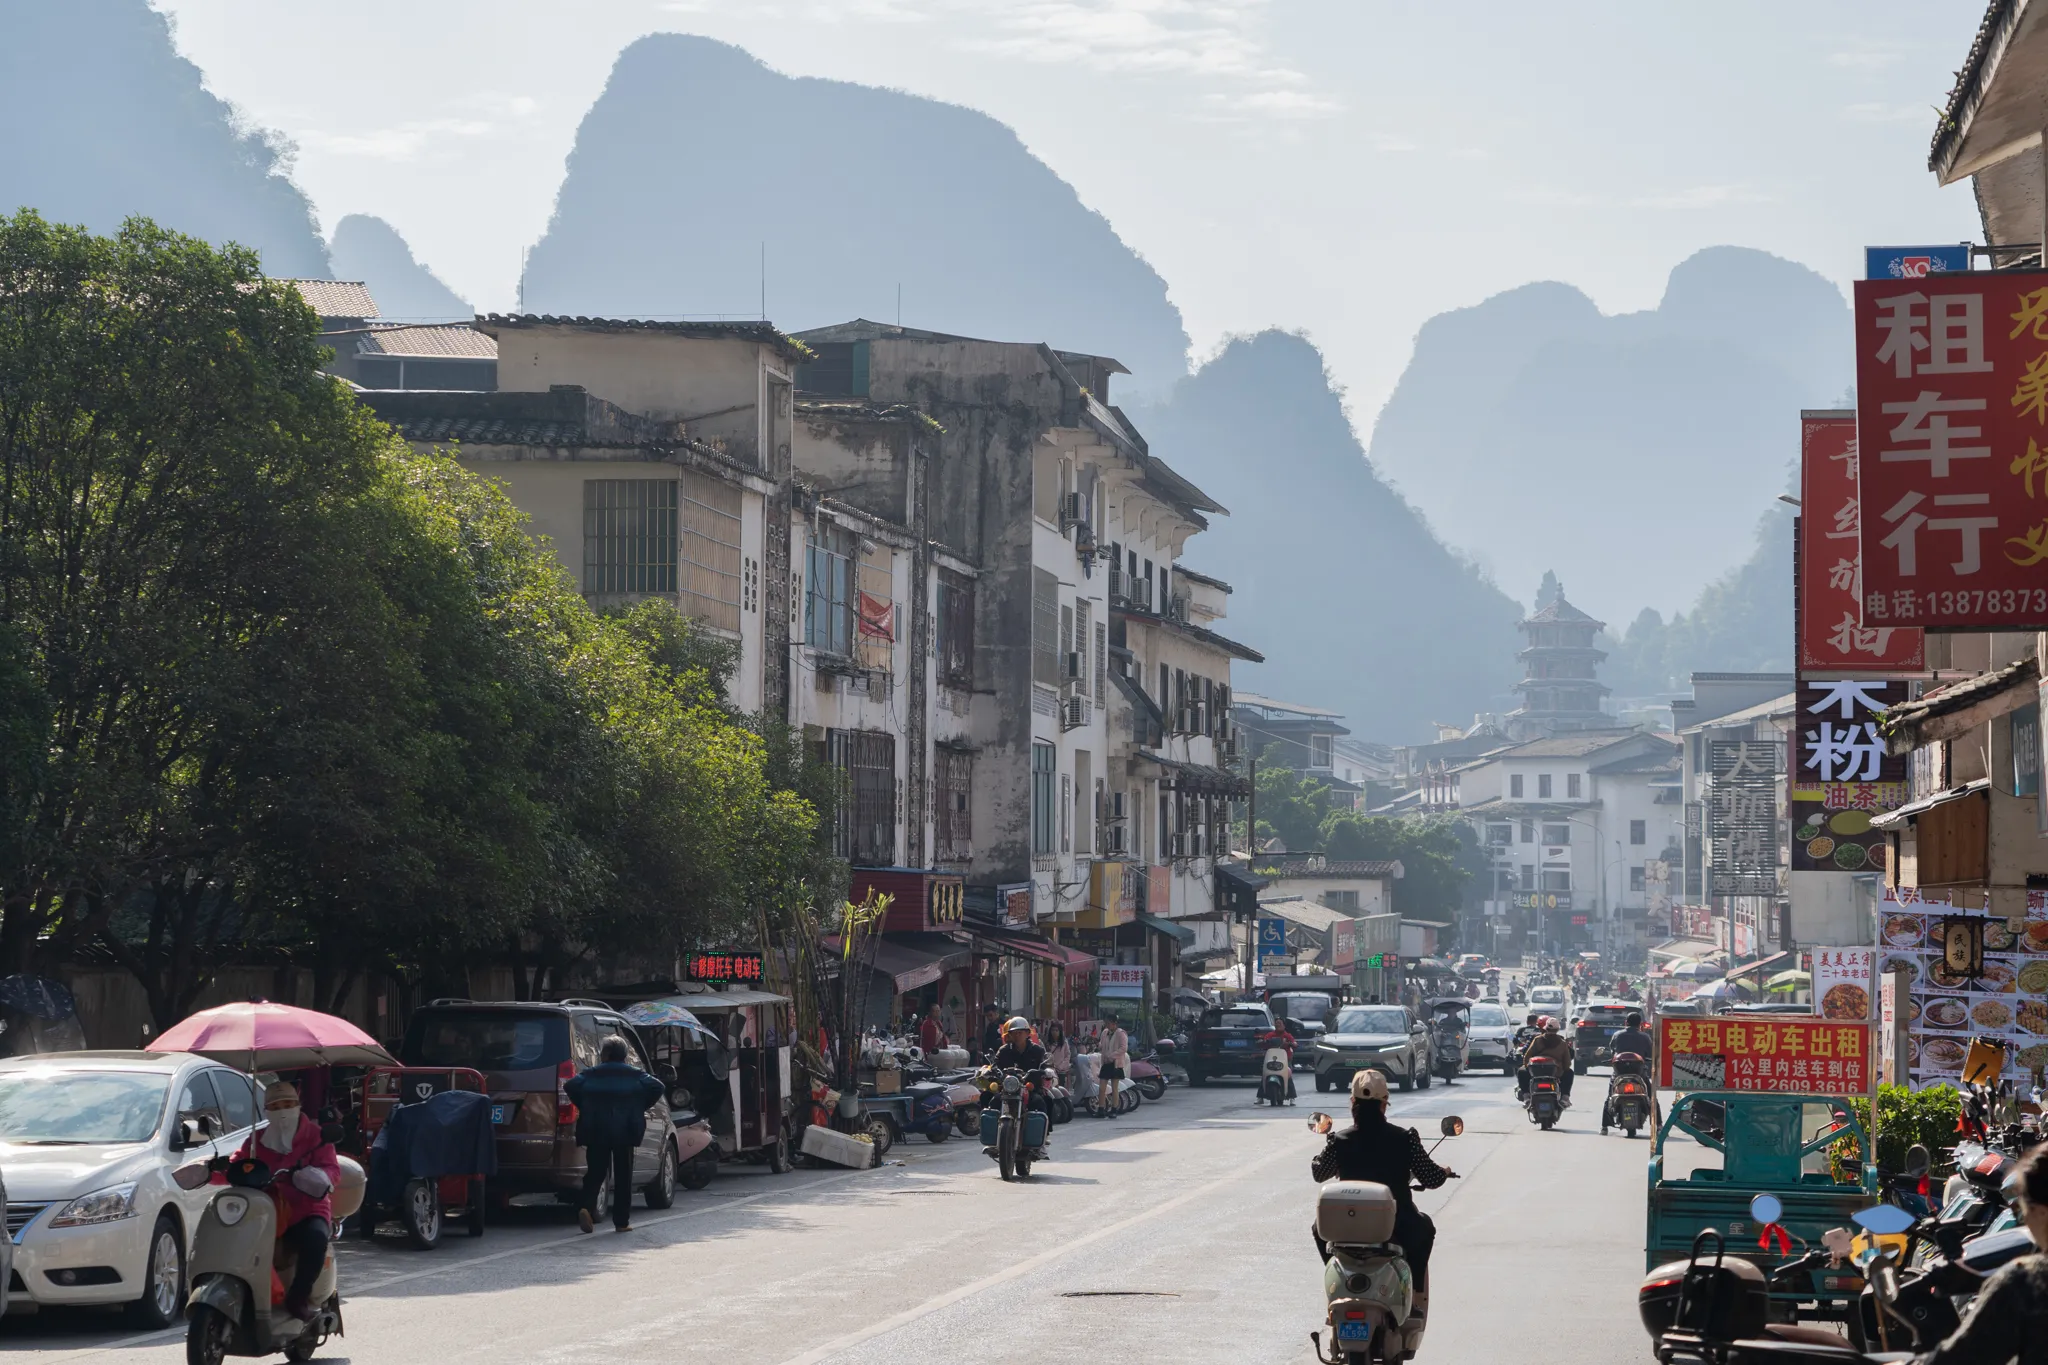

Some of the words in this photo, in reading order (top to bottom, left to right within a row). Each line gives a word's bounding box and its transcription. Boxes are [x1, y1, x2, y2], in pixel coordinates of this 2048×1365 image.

[1875, 291, 1998, 577] 租车行
[1823, 783, 1878, 809] 油茶
[1952, 933, 1967, 962] 民族
[734, 956, 761, 980] 电动车
[1821, 969, 1870, 979] 二十年老店
[1668, 1021, 1861, 1058] 爱玛电动车出租
[1731, 1058, 1861, 1079] 1公里内送车到位
